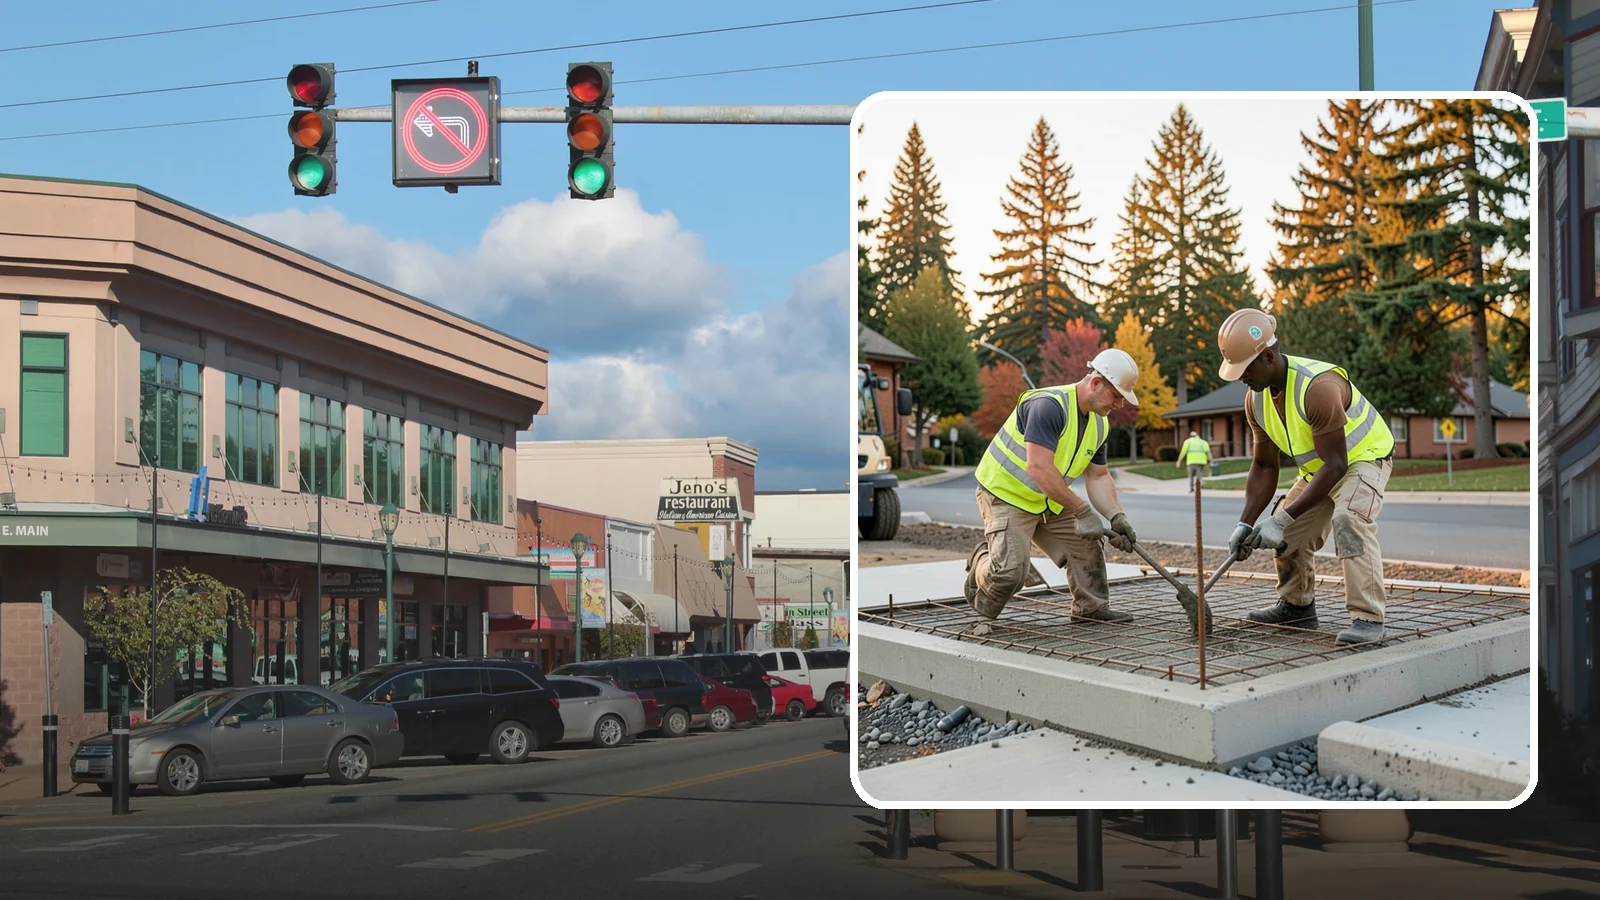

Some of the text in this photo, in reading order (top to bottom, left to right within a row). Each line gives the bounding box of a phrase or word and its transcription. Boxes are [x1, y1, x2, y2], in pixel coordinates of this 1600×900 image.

[669, 480, 727, 495] Jeno's
[665, 496, 731, 509] restaurant
[658, 510, 681, 519] Italian
[686, 509, 714, 519] American
[715, 509, 738, 519] Cuisine
[2, 525, 49, 536] E. MAIN
[797, 607, 829, 617] Street
